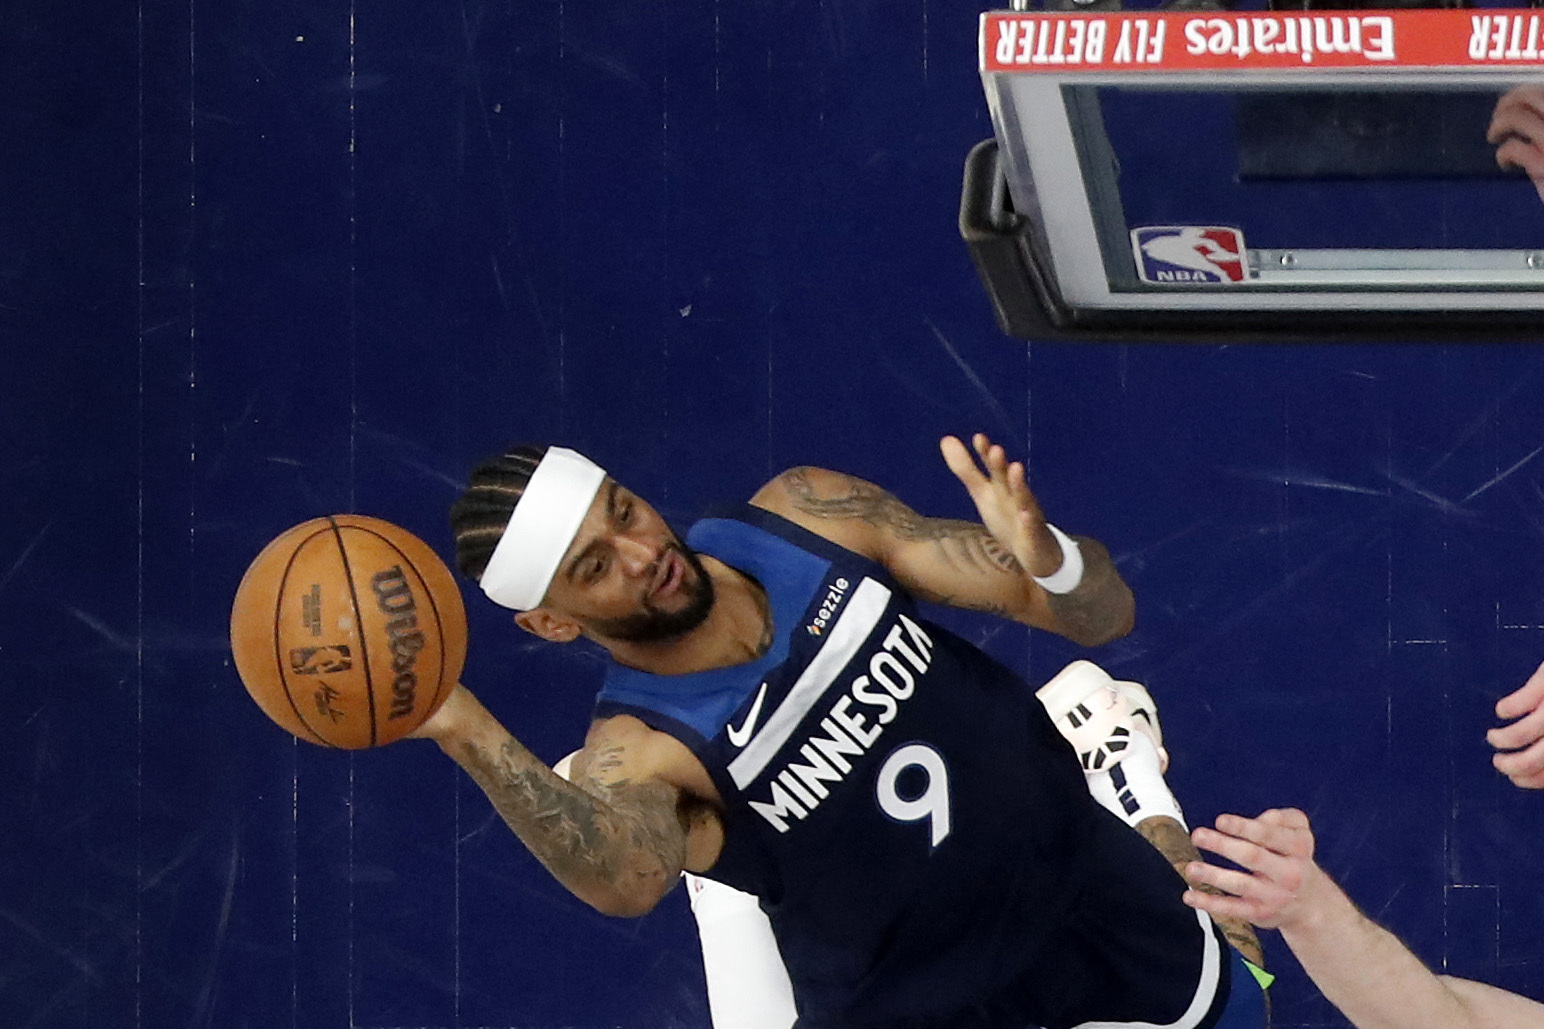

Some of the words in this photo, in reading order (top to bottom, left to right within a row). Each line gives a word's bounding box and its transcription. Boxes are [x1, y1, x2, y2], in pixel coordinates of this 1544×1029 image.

[995, 19, 1106, 65] BETTER
[1112, 18, 1166, 63] FLY
[1184, 15, 1396, 63] Emirates
[1156, 270, 1208, 282] NBA
[812, 577, 850, 629] sezzle
[371, 564, 426, 721] Wilson
[747, 613, 934, 834] MINNESOTA
[876, 743, 951, 848] 9
